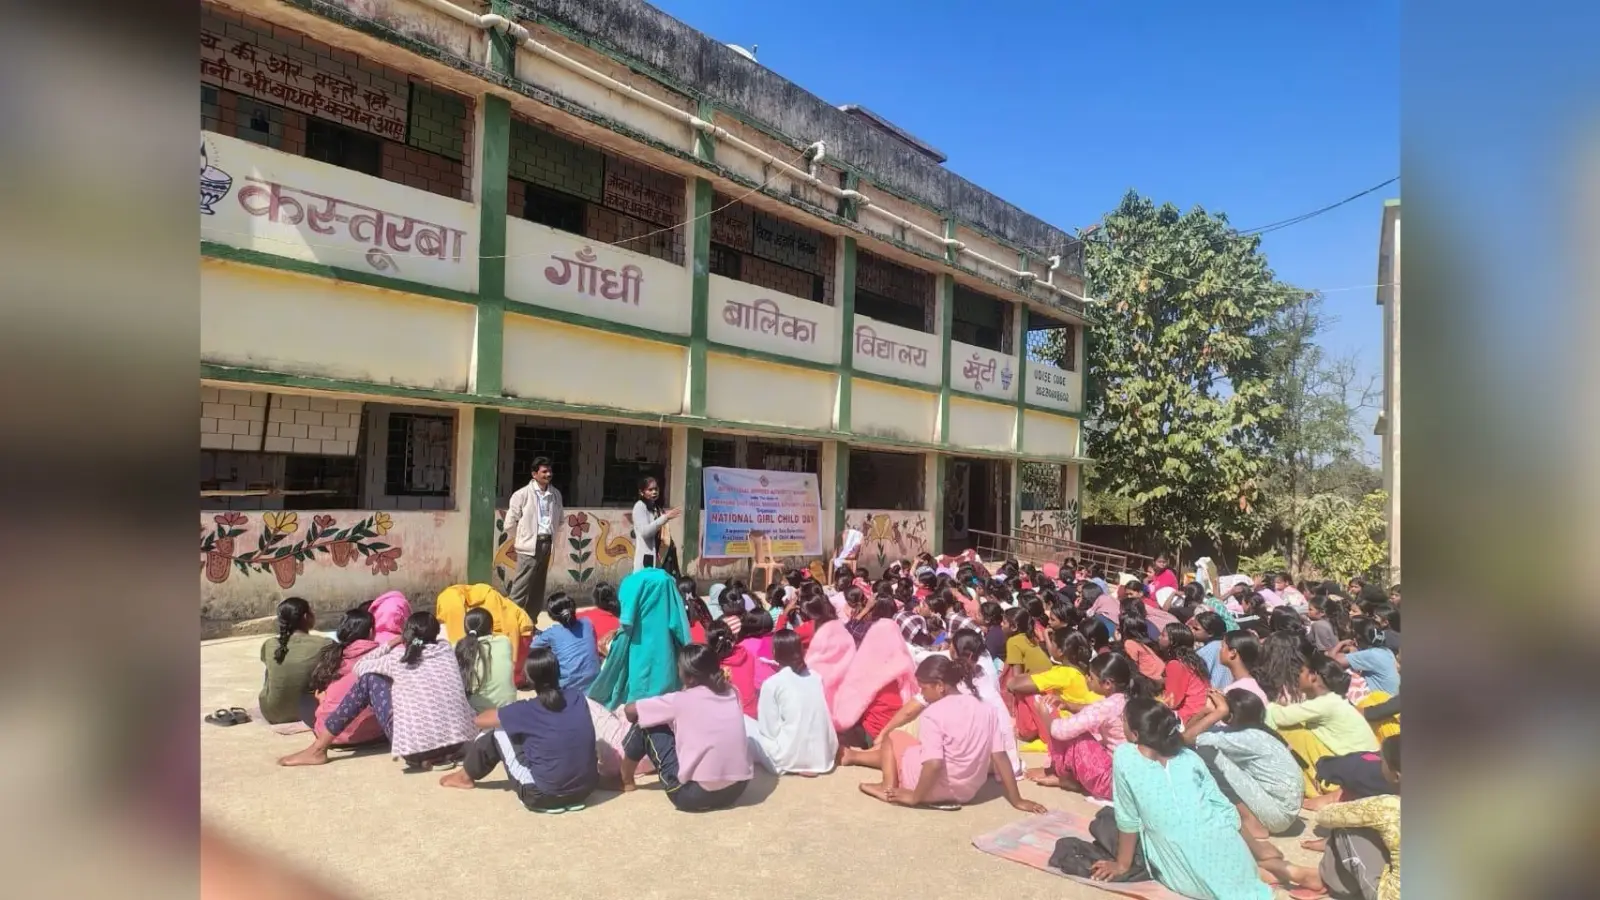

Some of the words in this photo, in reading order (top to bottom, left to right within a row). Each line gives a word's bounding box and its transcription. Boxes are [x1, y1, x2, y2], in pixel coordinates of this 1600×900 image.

[231, 41, 258, 65] की
[238, 175, 467, 272] कस्तूरबा
[544, 245, 644, 306] गाँधी
[722, 299, 818, 344] बालिका
[1053, 375, 1066, 386] CODE
[711, 512, 754, 524] NATIONAL
[756, 513, 775, 524] GIRL
[778, 514, 799, 524] CHILD
[802, 515, 815, 524] DAY
